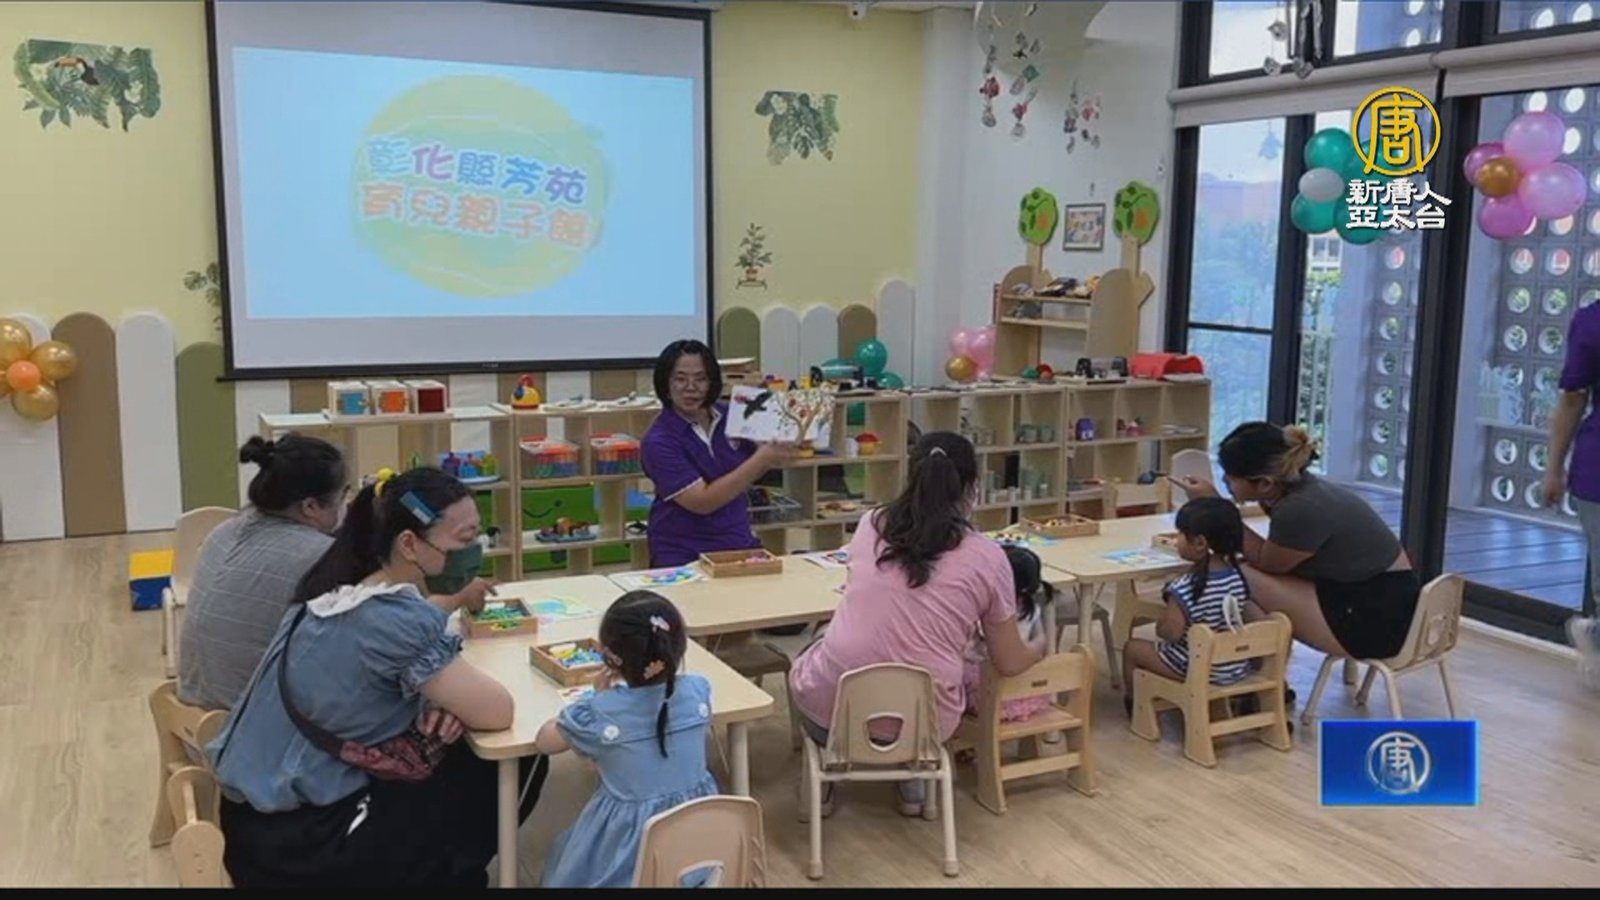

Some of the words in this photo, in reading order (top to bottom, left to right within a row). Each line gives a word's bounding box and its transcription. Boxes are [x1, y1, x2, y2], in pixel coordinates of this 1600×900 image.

[367, 138, 588, 204] 彰化縣芳苑
[362, 183, 590, 246] 育兒親子館
